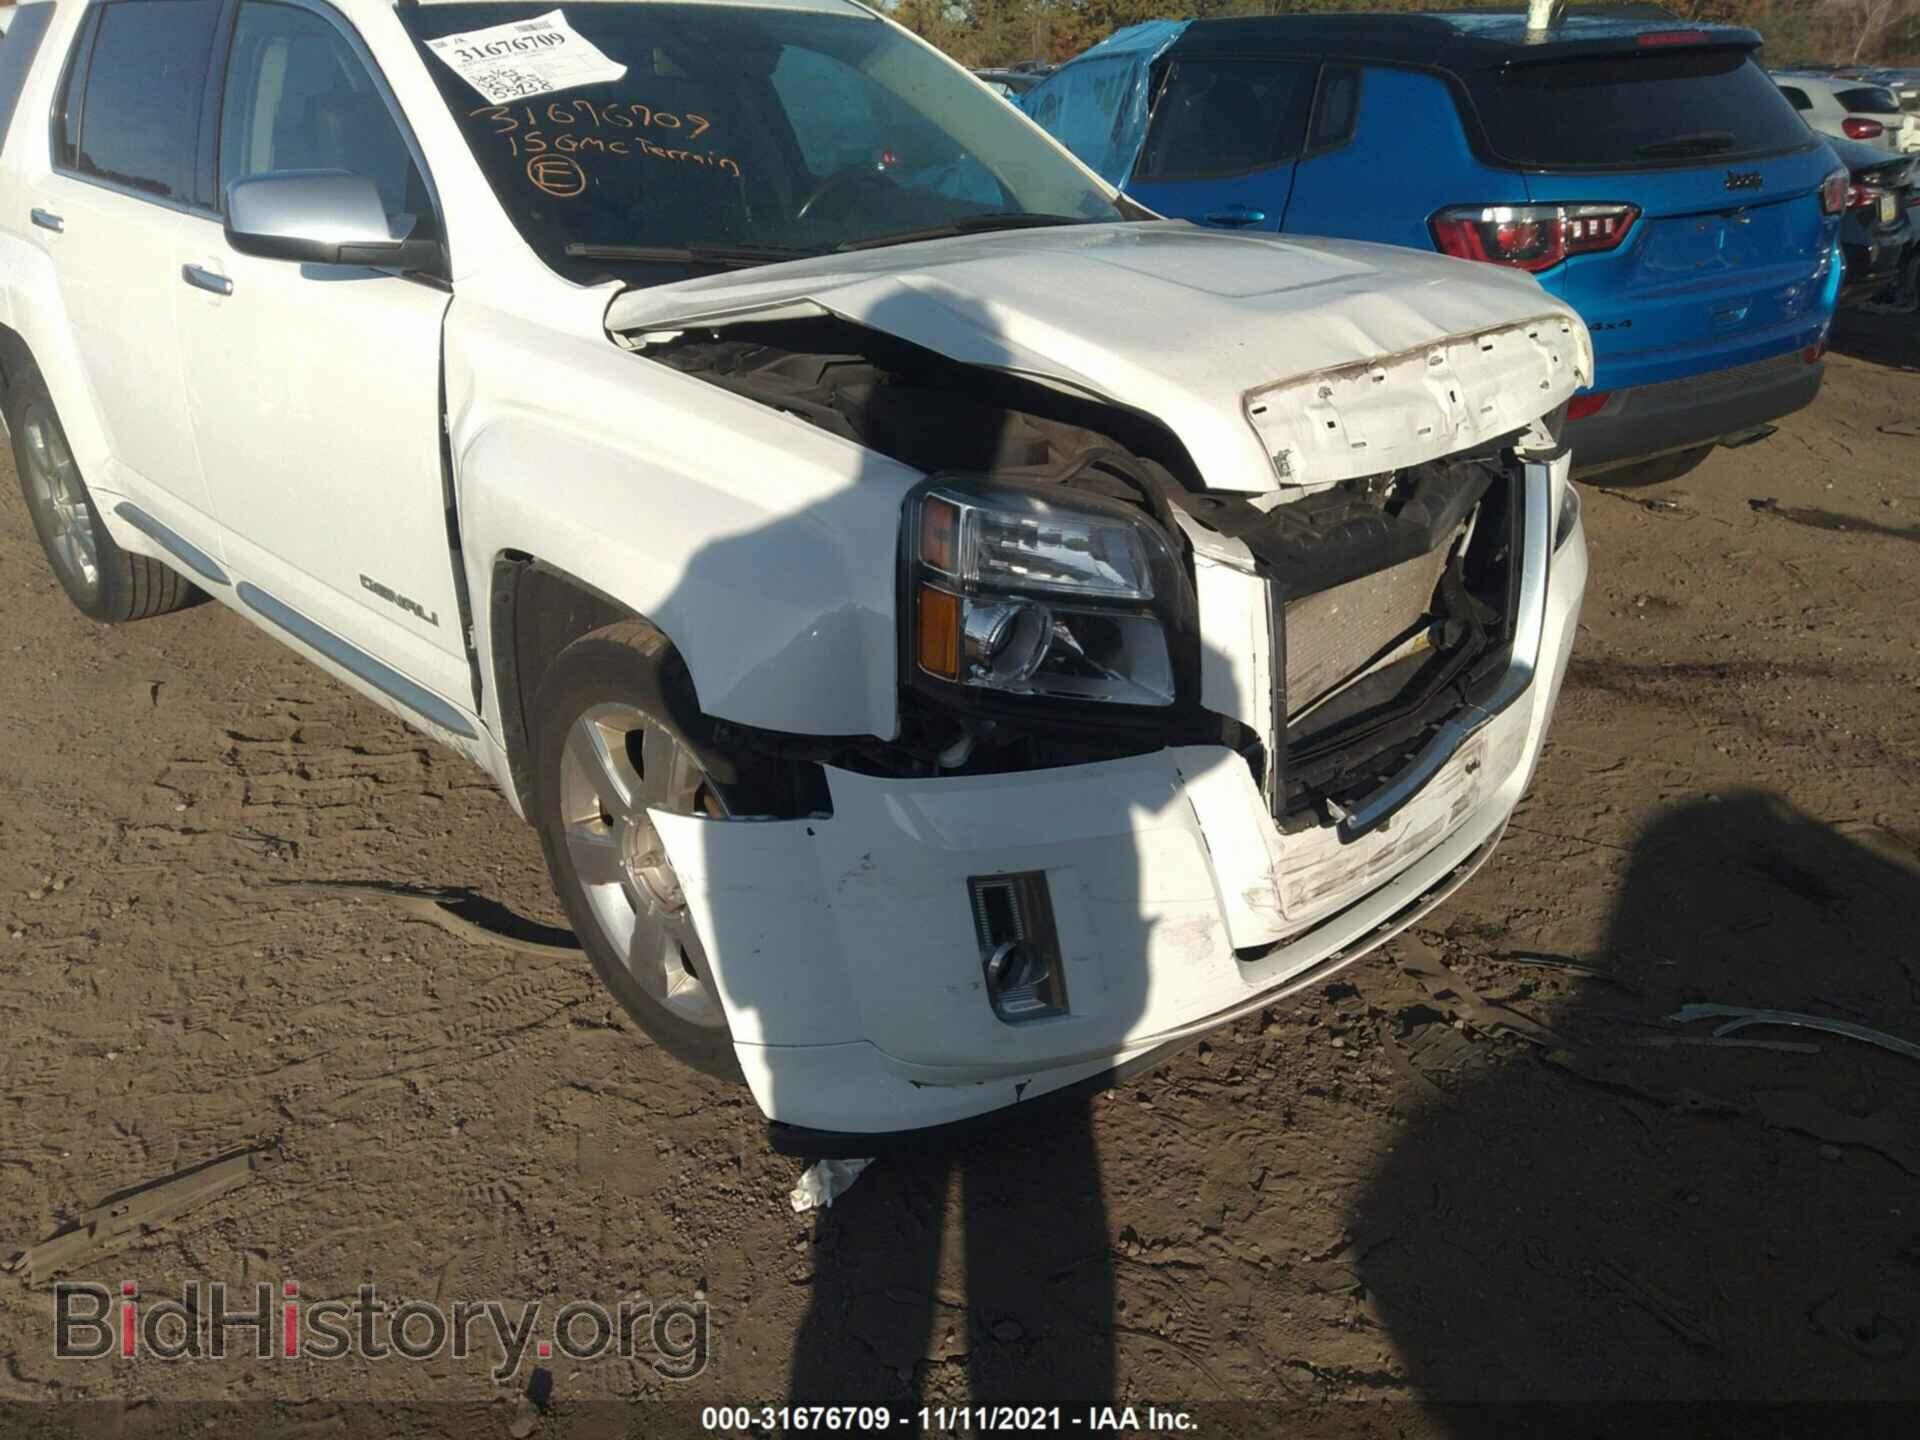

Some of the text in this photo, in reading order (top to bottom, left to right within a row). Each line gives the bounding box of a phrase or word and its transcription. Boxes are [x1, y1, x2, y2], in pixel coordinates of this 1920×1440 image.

[454, 32, 566, 62] 31676709
[469, 100, 711, 139] 31676709
[359, 573, 440, 628] DENALI
